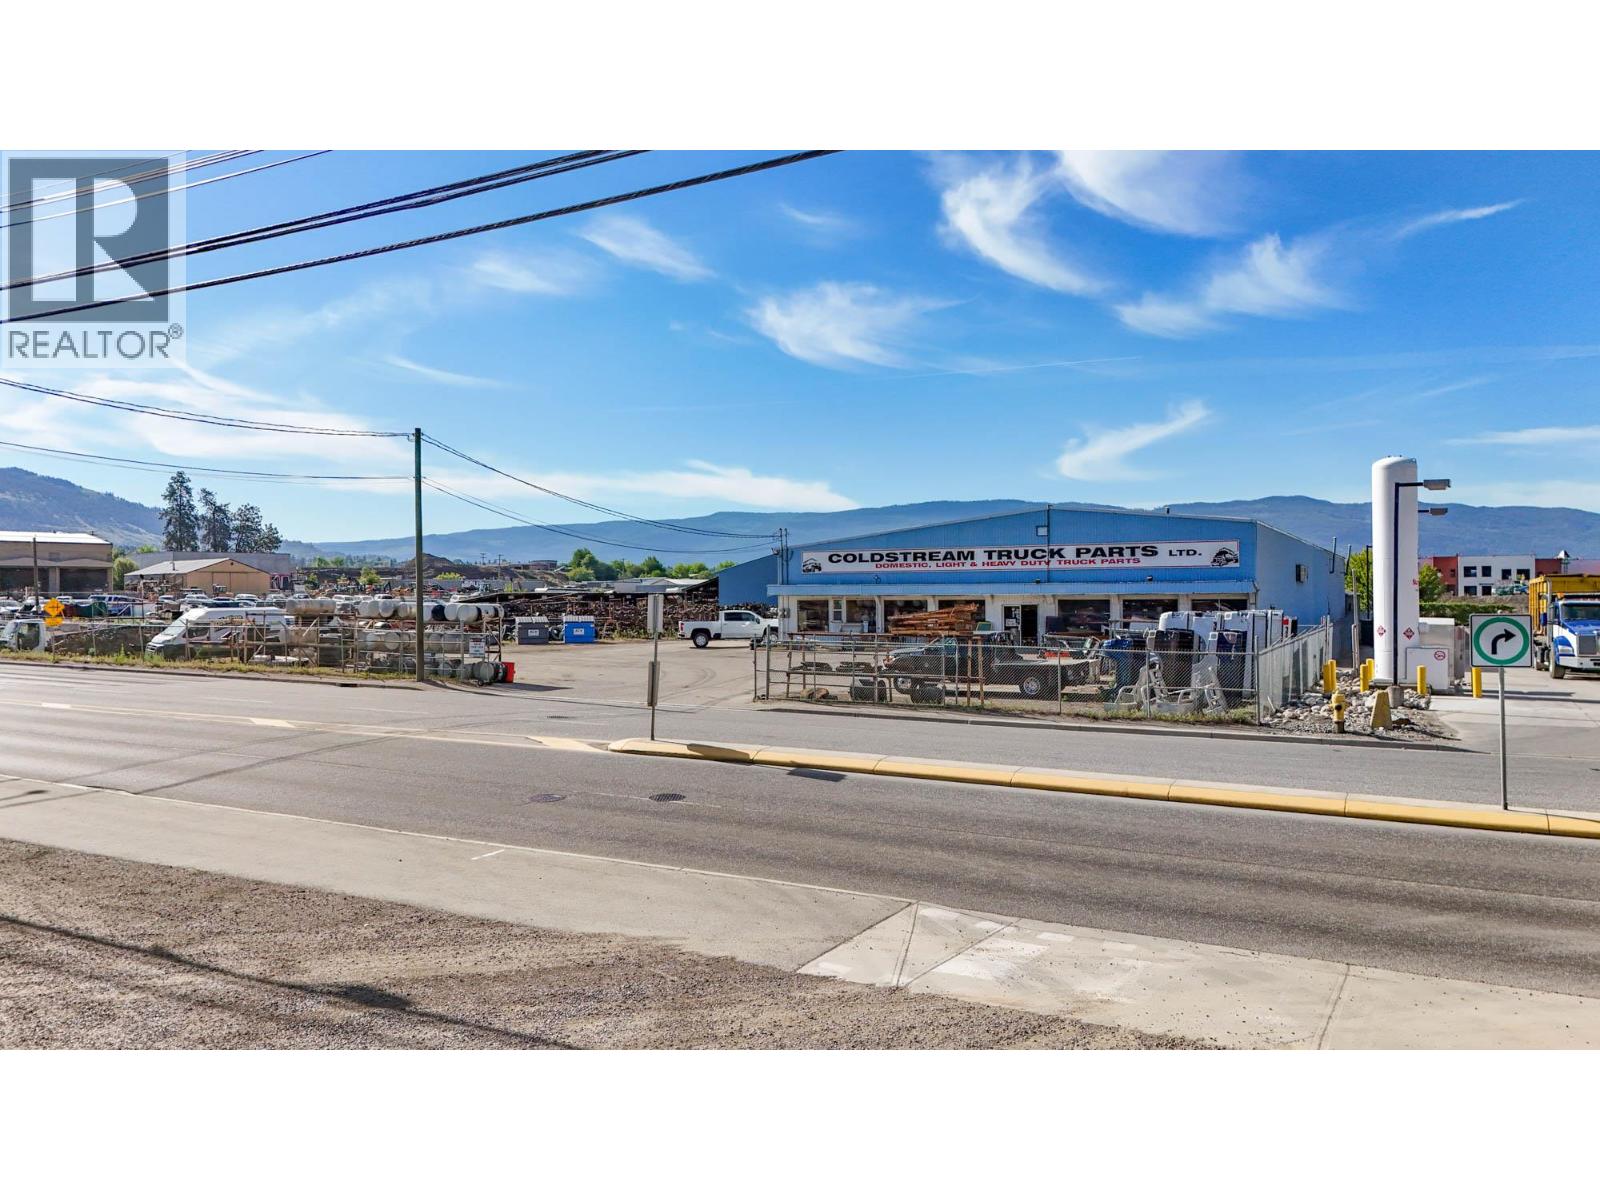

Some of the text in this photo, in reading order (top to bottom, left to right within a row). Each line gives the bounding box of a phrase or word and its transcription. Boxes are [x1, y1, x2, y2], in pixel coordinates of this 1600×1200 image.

[828, 545, 1202, 563] COLDSTREAM TRUCK PARTS LTD.
